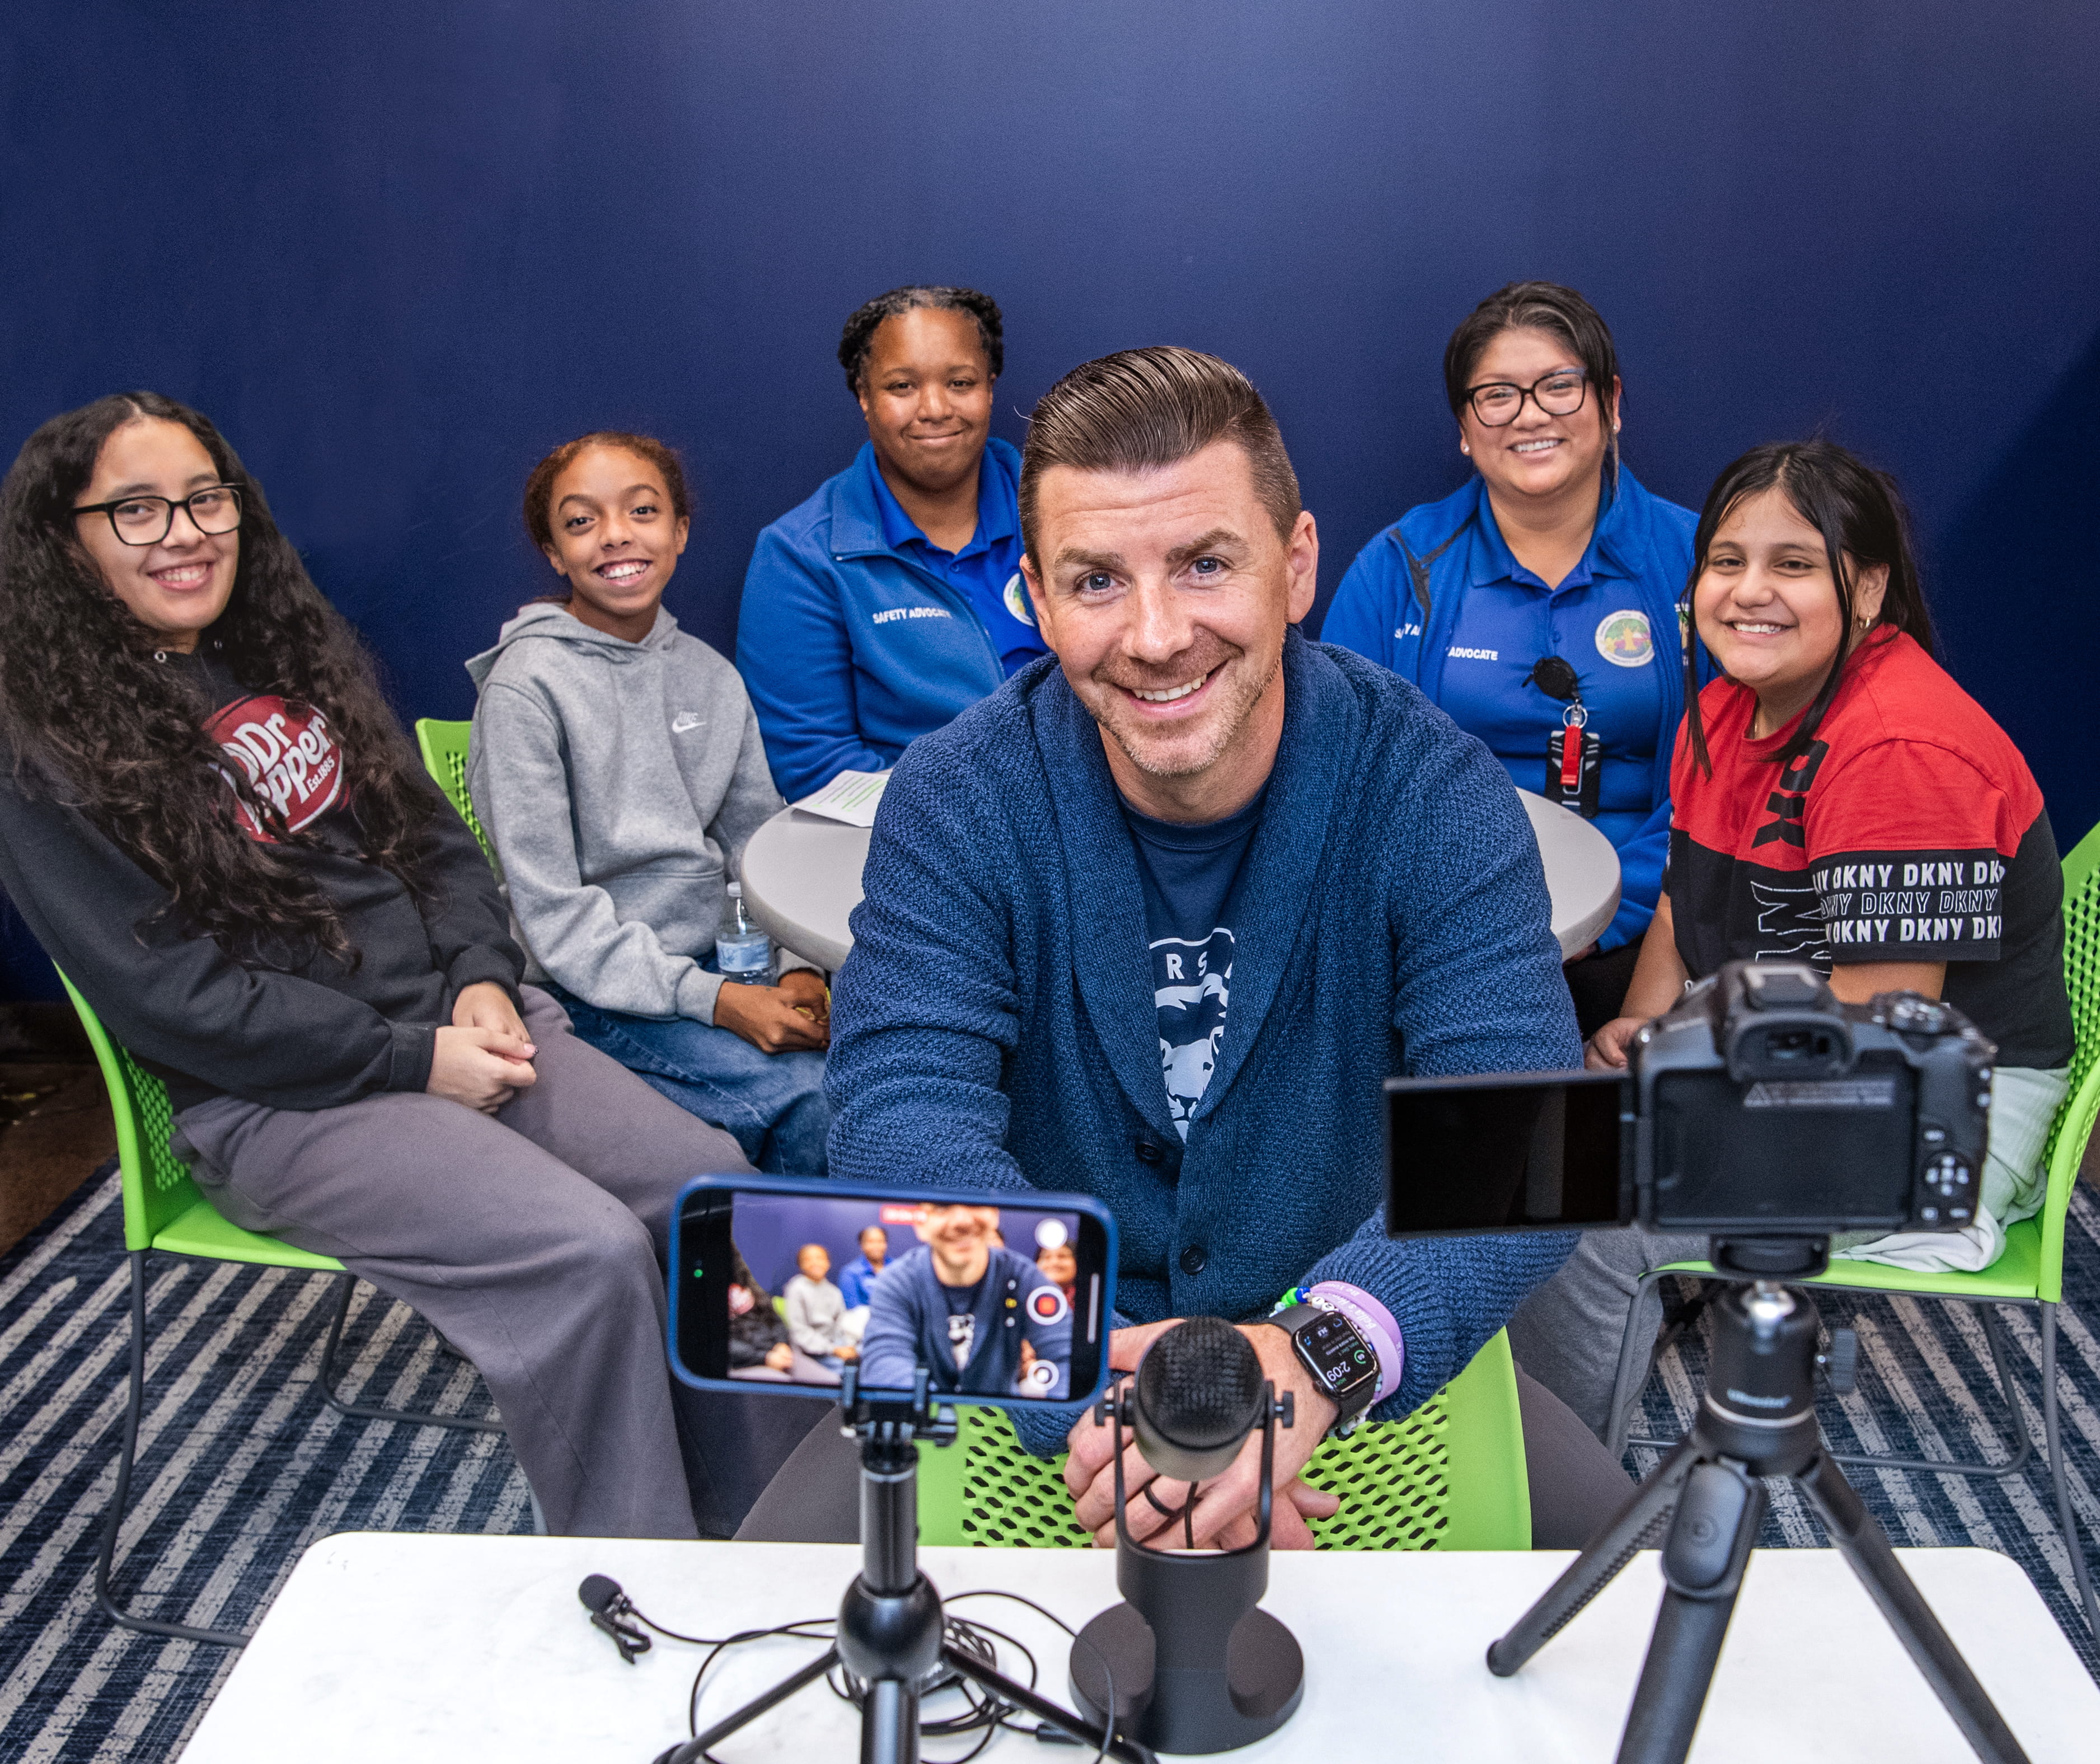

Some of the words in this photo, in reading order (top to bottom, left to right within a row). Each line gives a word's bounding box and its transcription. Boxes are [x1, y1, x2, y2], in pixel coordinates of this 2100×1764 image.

[873, 608, 907, 624] SAFETY
[1447, 646, 1499, 661] ADVOCATE
[232, 712, 292, 773] Dr
[307, 755, 335, 792] Est.1885
[1832, 864, 1893, 889] DKNY
[1903, 862, 1963, 886] DKNY
[1973, 860, 2006, 885] DK
[1861, 892, 1930, 914] DKNY
[1939, 889, 1998, 913] DKNY
[1832, 919, 1890, 944] DKNY
[1900, 918, 1963, 942] DKNY
[1972, 915, 2001, 940] DK
[1326, 1361, 1351, 1381] 2:09
